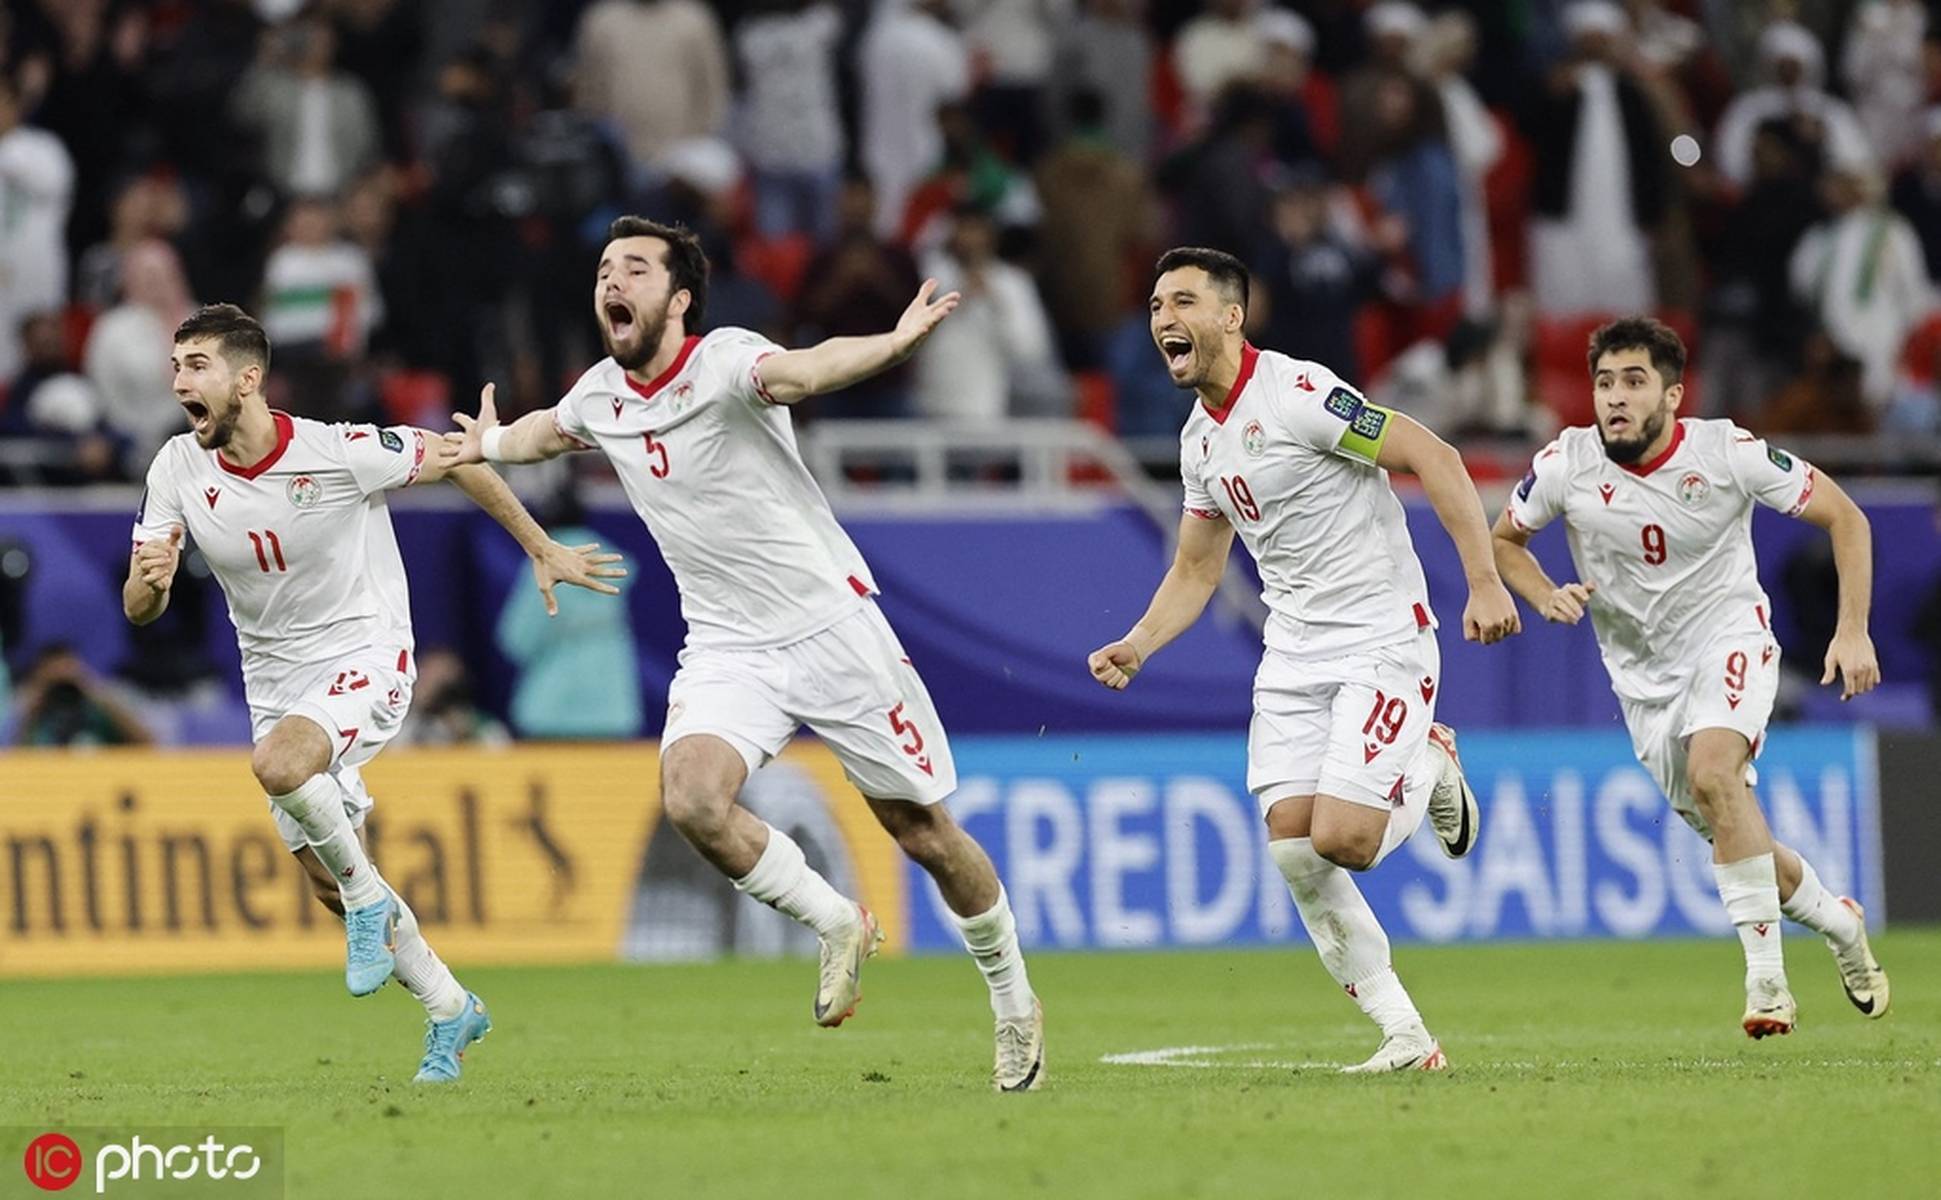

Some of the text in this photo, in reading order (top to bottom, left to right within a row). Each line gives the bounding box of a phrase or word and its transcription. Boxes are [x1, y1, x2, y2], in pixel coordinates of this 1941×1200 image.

[642, 430, 670, 479] 5
[1220, 474, 1260, 522] 19
[248, 530, 286, 573] 11
[1641, 523, 1667, 566] 9
[1724, 651, 1748, 692] 9
[888, 701, 924, 756] 5
[1362, 689, 1408, 745] 19
[917, 774, 1298, 948] CREDI
